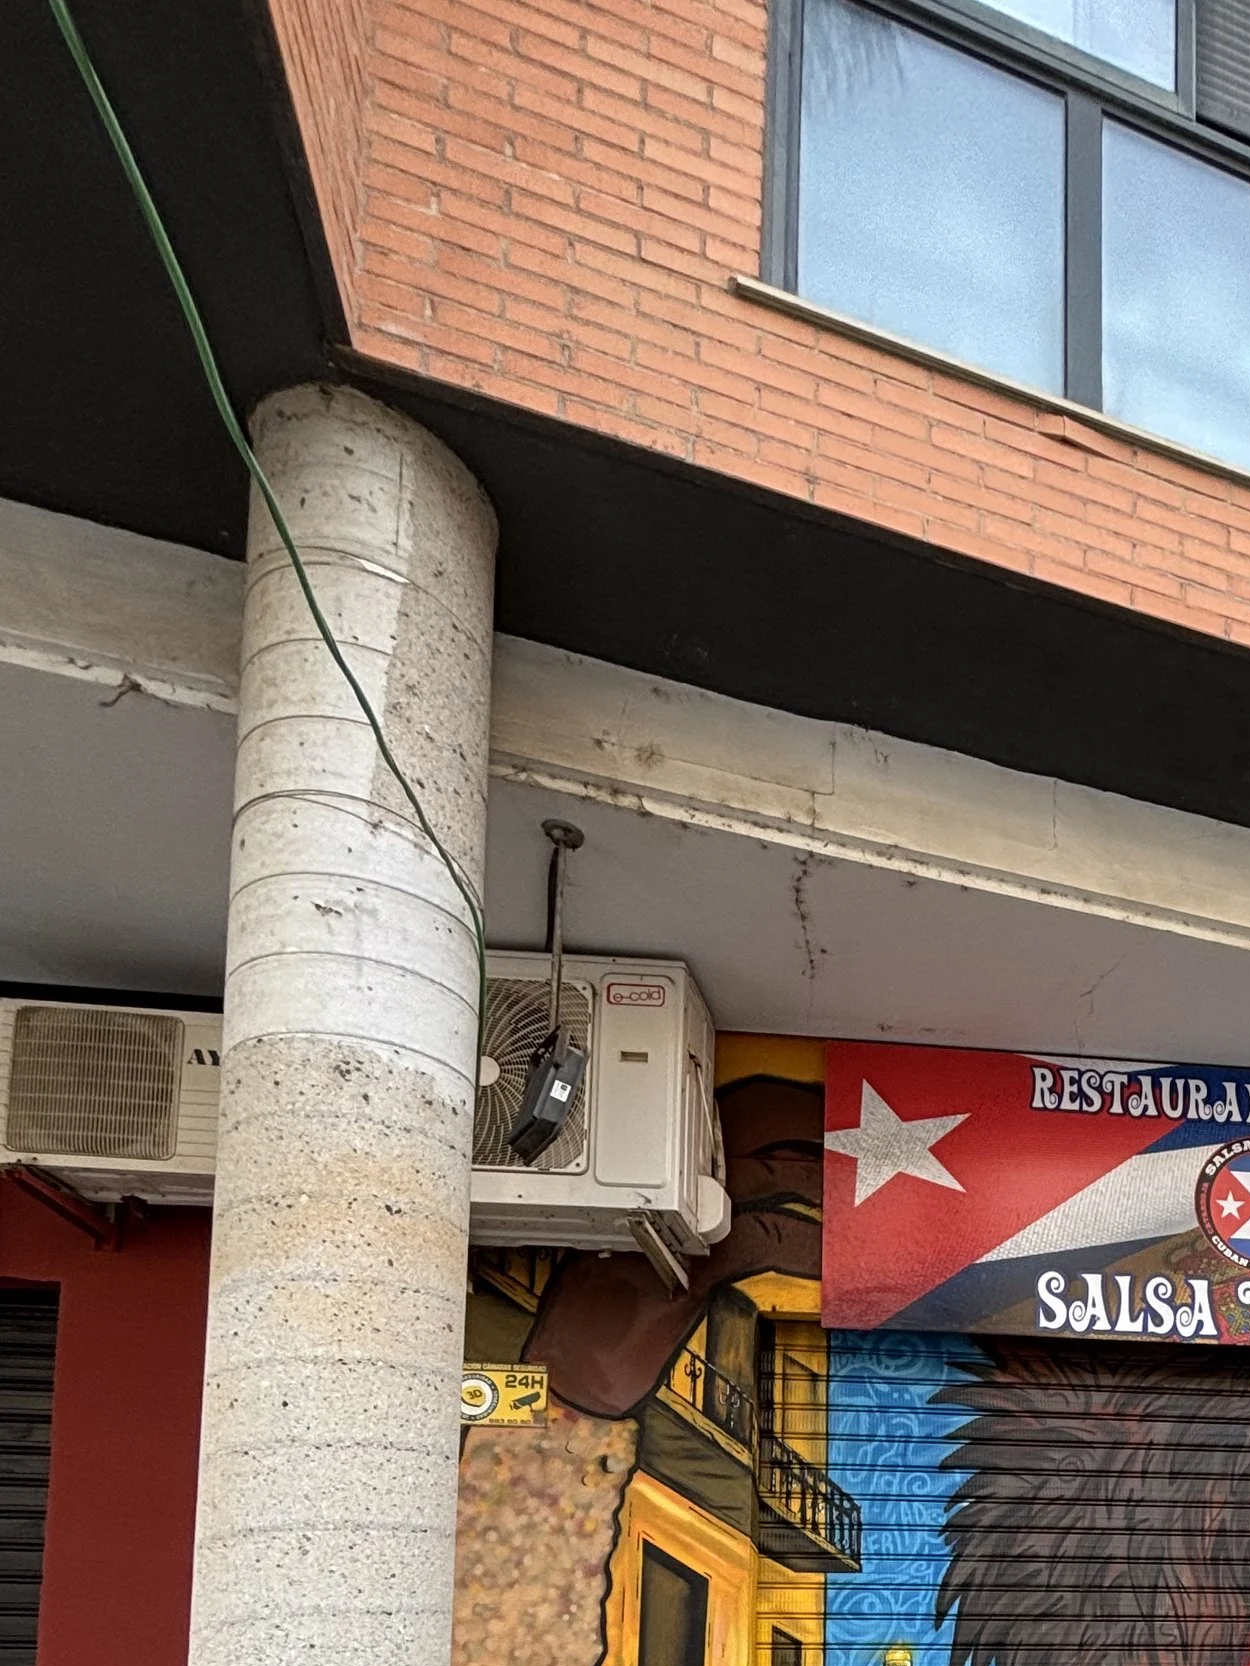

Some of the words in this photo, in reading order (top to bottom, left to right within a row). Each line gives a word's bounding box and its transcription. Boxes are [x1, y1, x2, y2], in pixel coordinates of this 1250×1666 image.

[1211, 1235, 1249, 1267] CUBAN
[1037, 1270, 1219, 1338] SALSA
[466, 1388, 484, 1400] 3D
[505, 1374, 544, 1390] 24H
